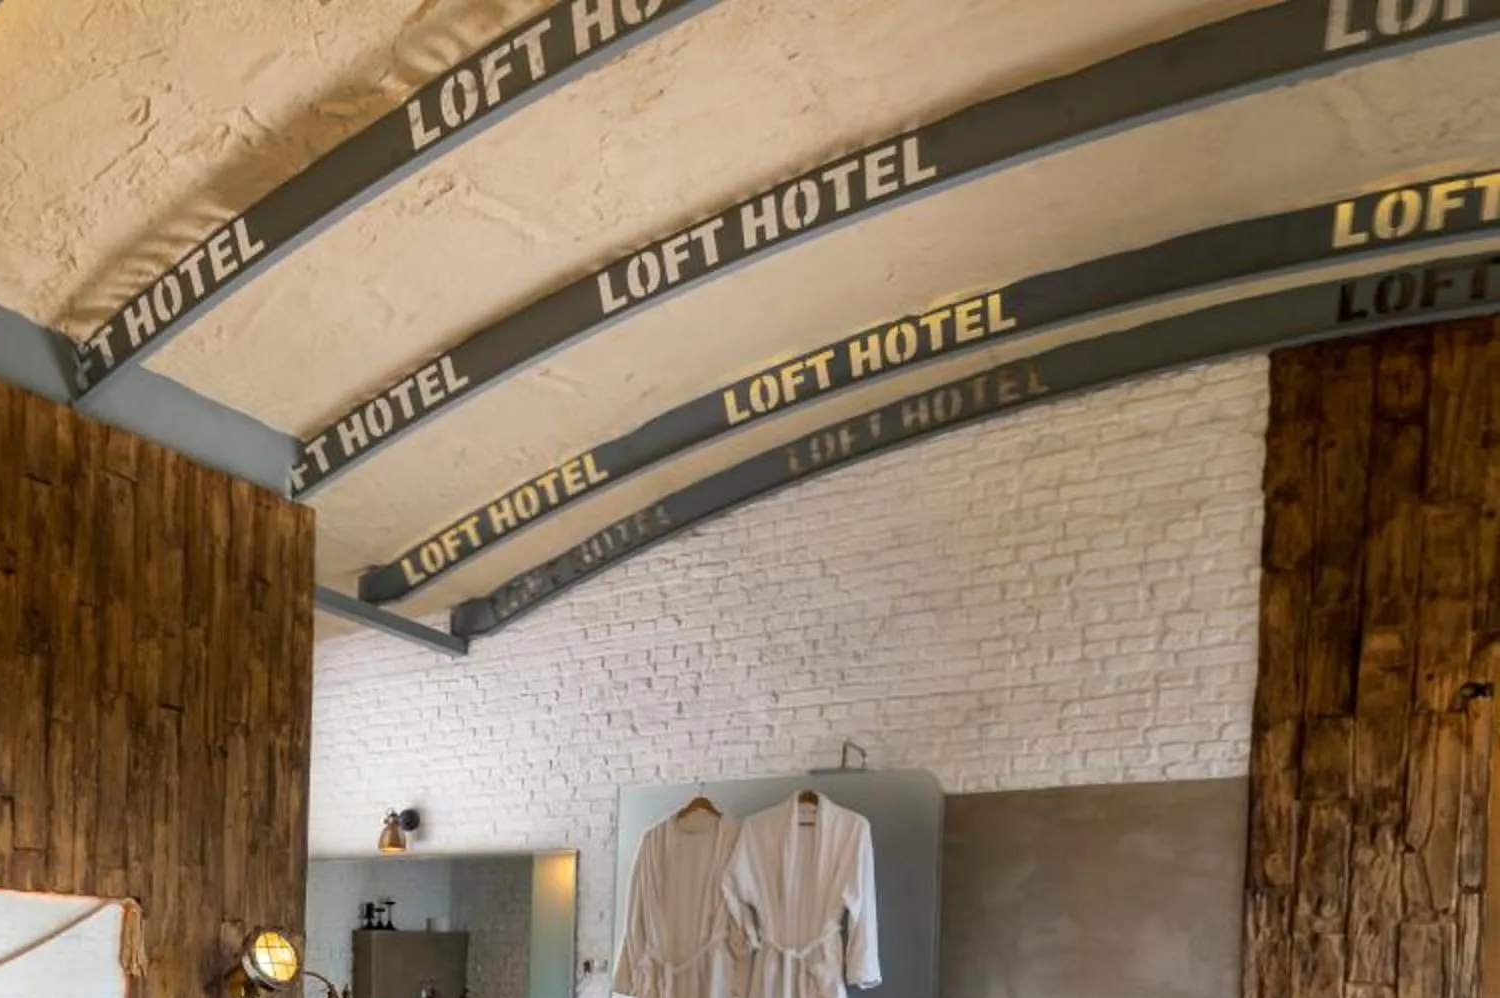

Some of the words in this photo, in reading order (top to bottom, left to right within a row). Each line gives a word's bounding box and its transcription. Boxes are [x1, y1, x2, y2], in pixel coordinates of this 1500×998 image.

[406, 18, 552, 151] LOFT
[597, 218, 724, 315] LOFT
[740, 136, 937, 250] HOTEL
[1331, 173, 1500, 249] LOFT
[122, 217, 265, 348] HOTEL
[336, 355, 470, 457] HOTEL
[723, 349, 835, 426] LOFT
[848, 293, 1017, 379] HOTEL
[900, 361, 1050, 431] HOTEL
[400, 515, 482, 577] LOFT
[487, 452, 609, 535] HOTEL
